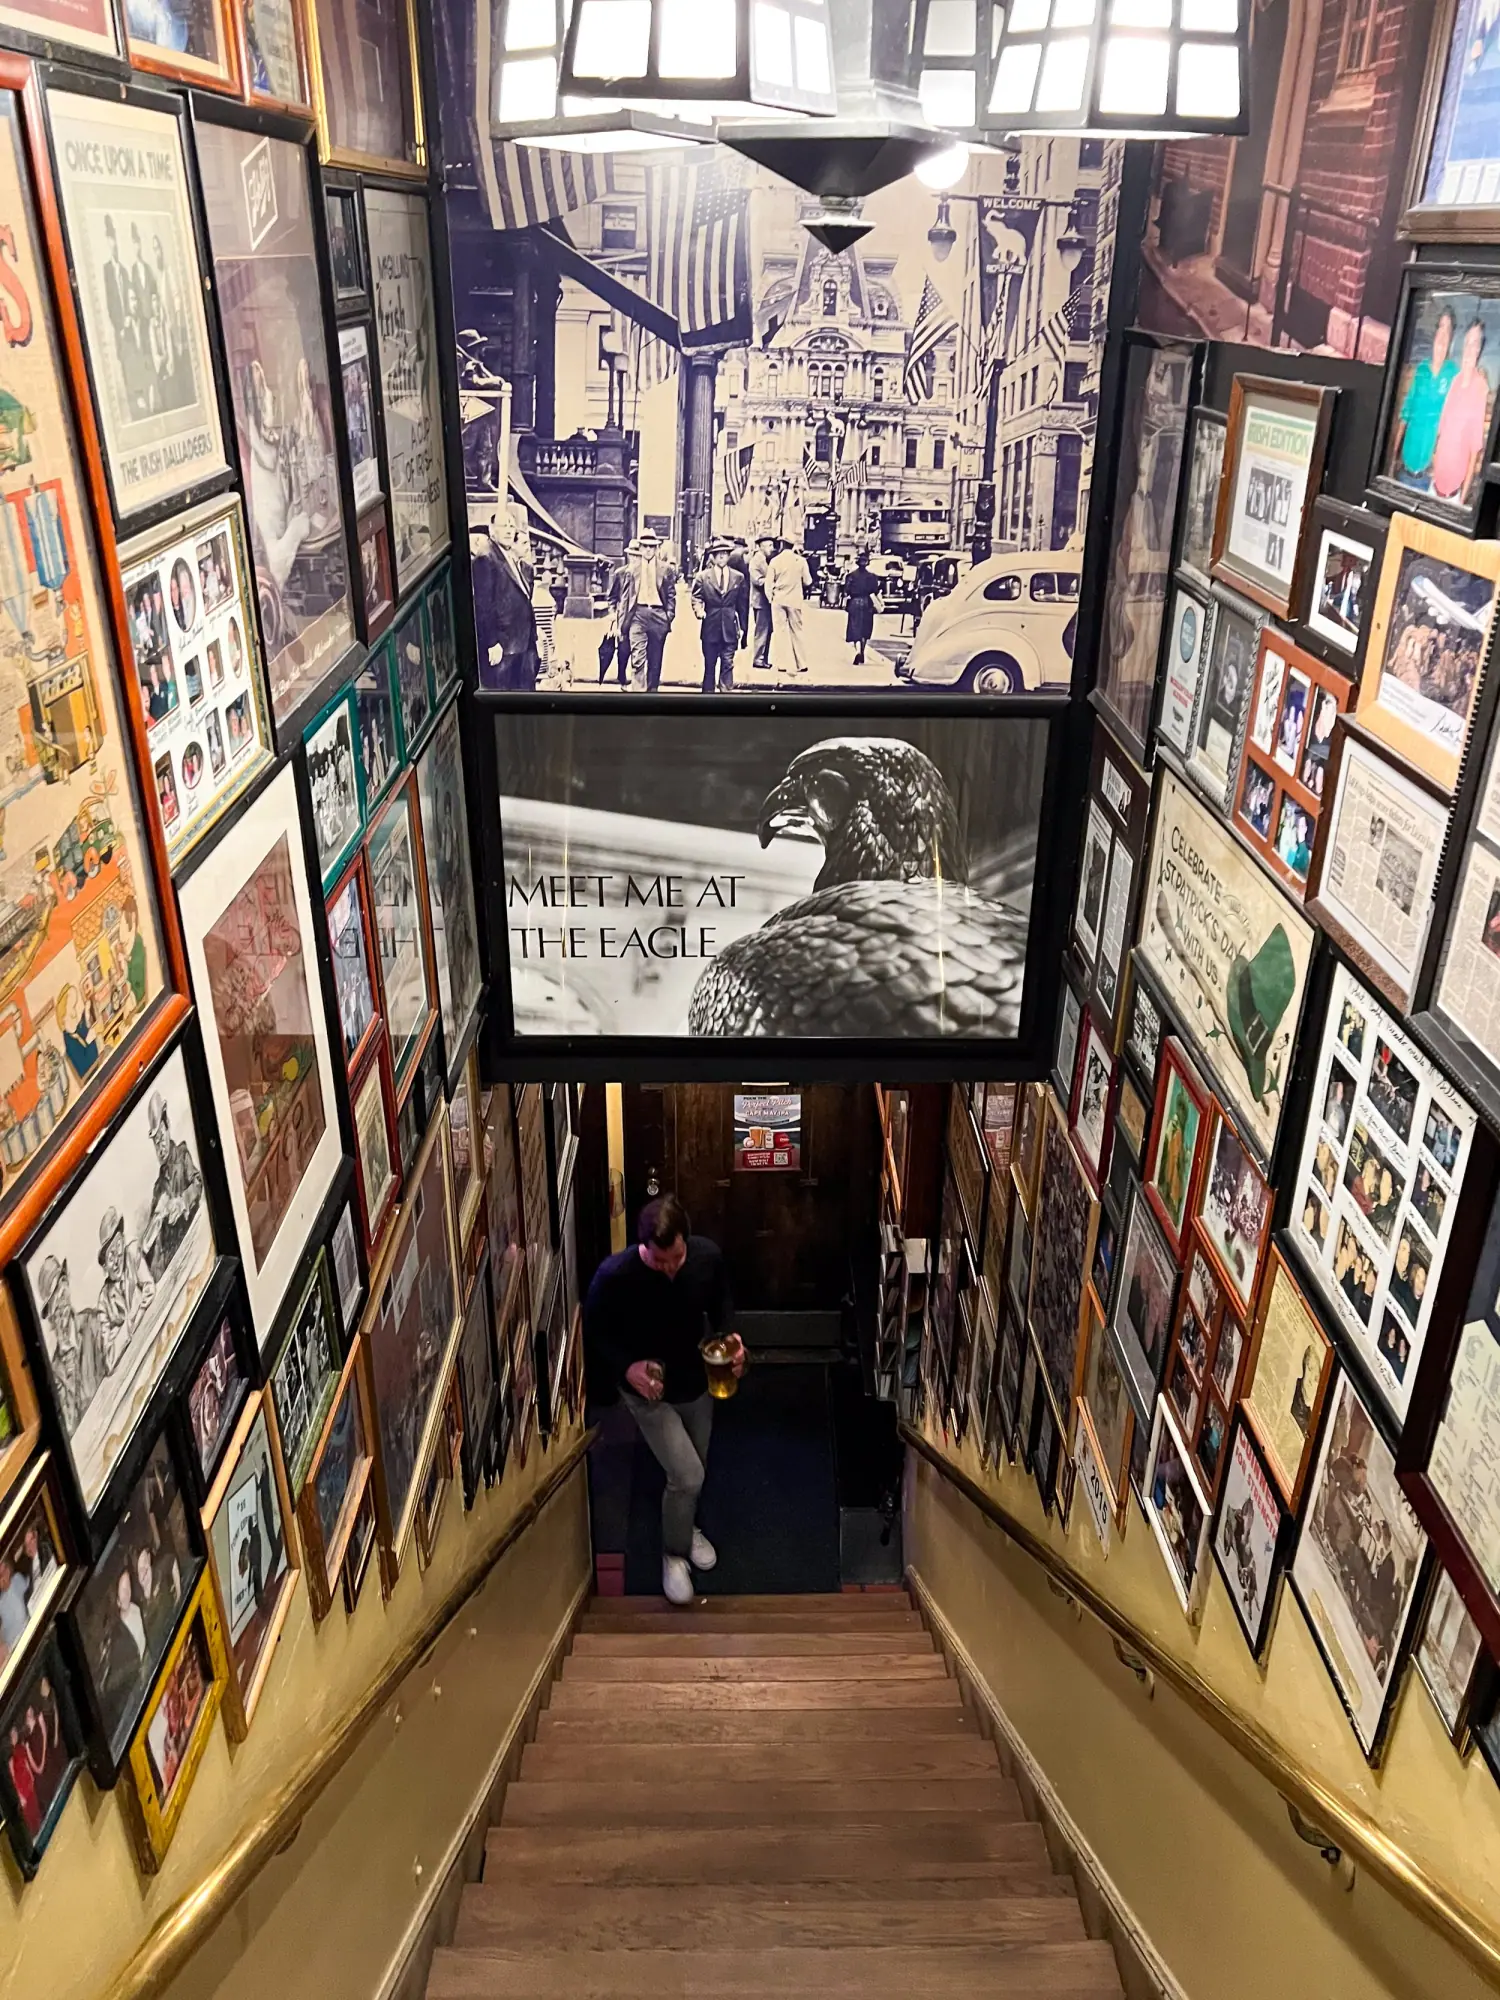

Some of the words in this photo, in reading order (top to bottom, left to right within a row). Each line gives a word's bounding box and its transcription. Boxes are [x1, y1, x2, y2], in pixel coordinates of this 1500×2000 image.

[65, 140, 104, 175] ONCE
[103, 144, 136, 178] UPON
[137, 149, 148, 179] A
[146, 151, 174, 182] TIME
[983, 197, 1042, 211] WELCOME
[270, 426, 312, 459] EDITION
[120, 456, 140, 486] THE
[140, 447, 163, 478] IRISH
[1171, 826, 1223, 905] CELEBRATE
[509, 875, 613, 907] MEET
[625, 875, 684, 907] ME
[696, 875, 746, 907] AT
[510, 927, 588, 958] THE
[599, 926, 717, 958] EAGLE
[1183, 924, 1205, 967] WITH
[1220, 930, 1247, 961] DAY
[770, 1097, 792, 1107] Pitch
[1090, 1464, 1108, 1525] 2015
